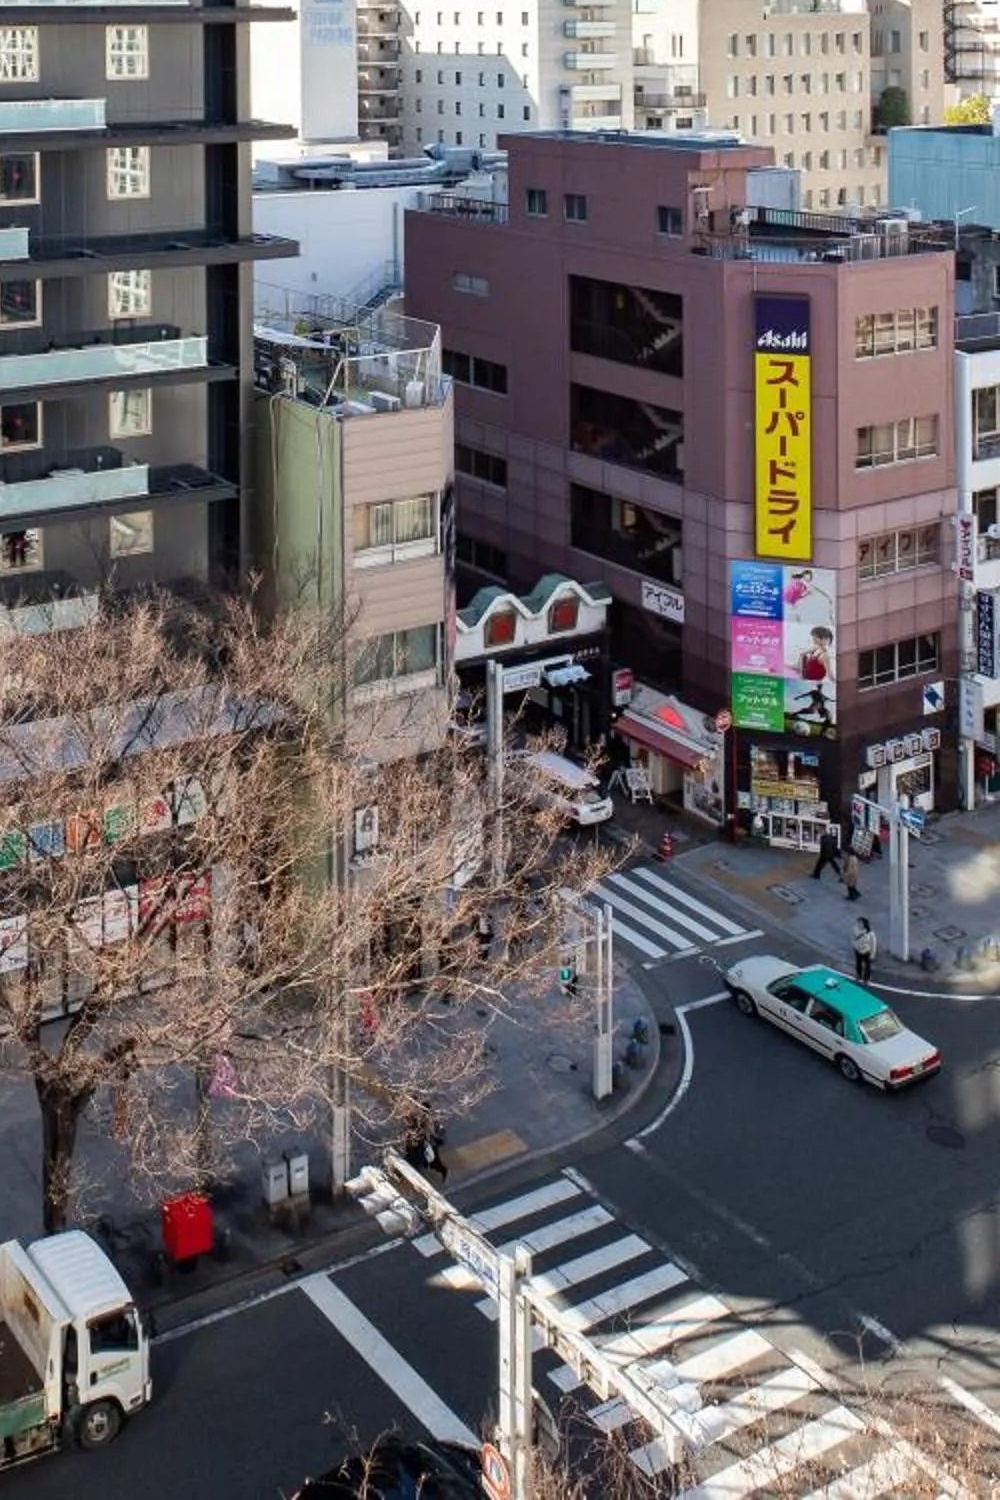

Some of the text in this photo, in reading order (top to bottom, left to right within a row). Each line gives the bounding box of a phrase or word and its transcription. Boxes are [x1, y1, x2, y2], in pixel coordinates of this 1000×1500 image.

[757, 329, 808, 350] Asahi
[765, 359, 805, 545] スーパードライ
